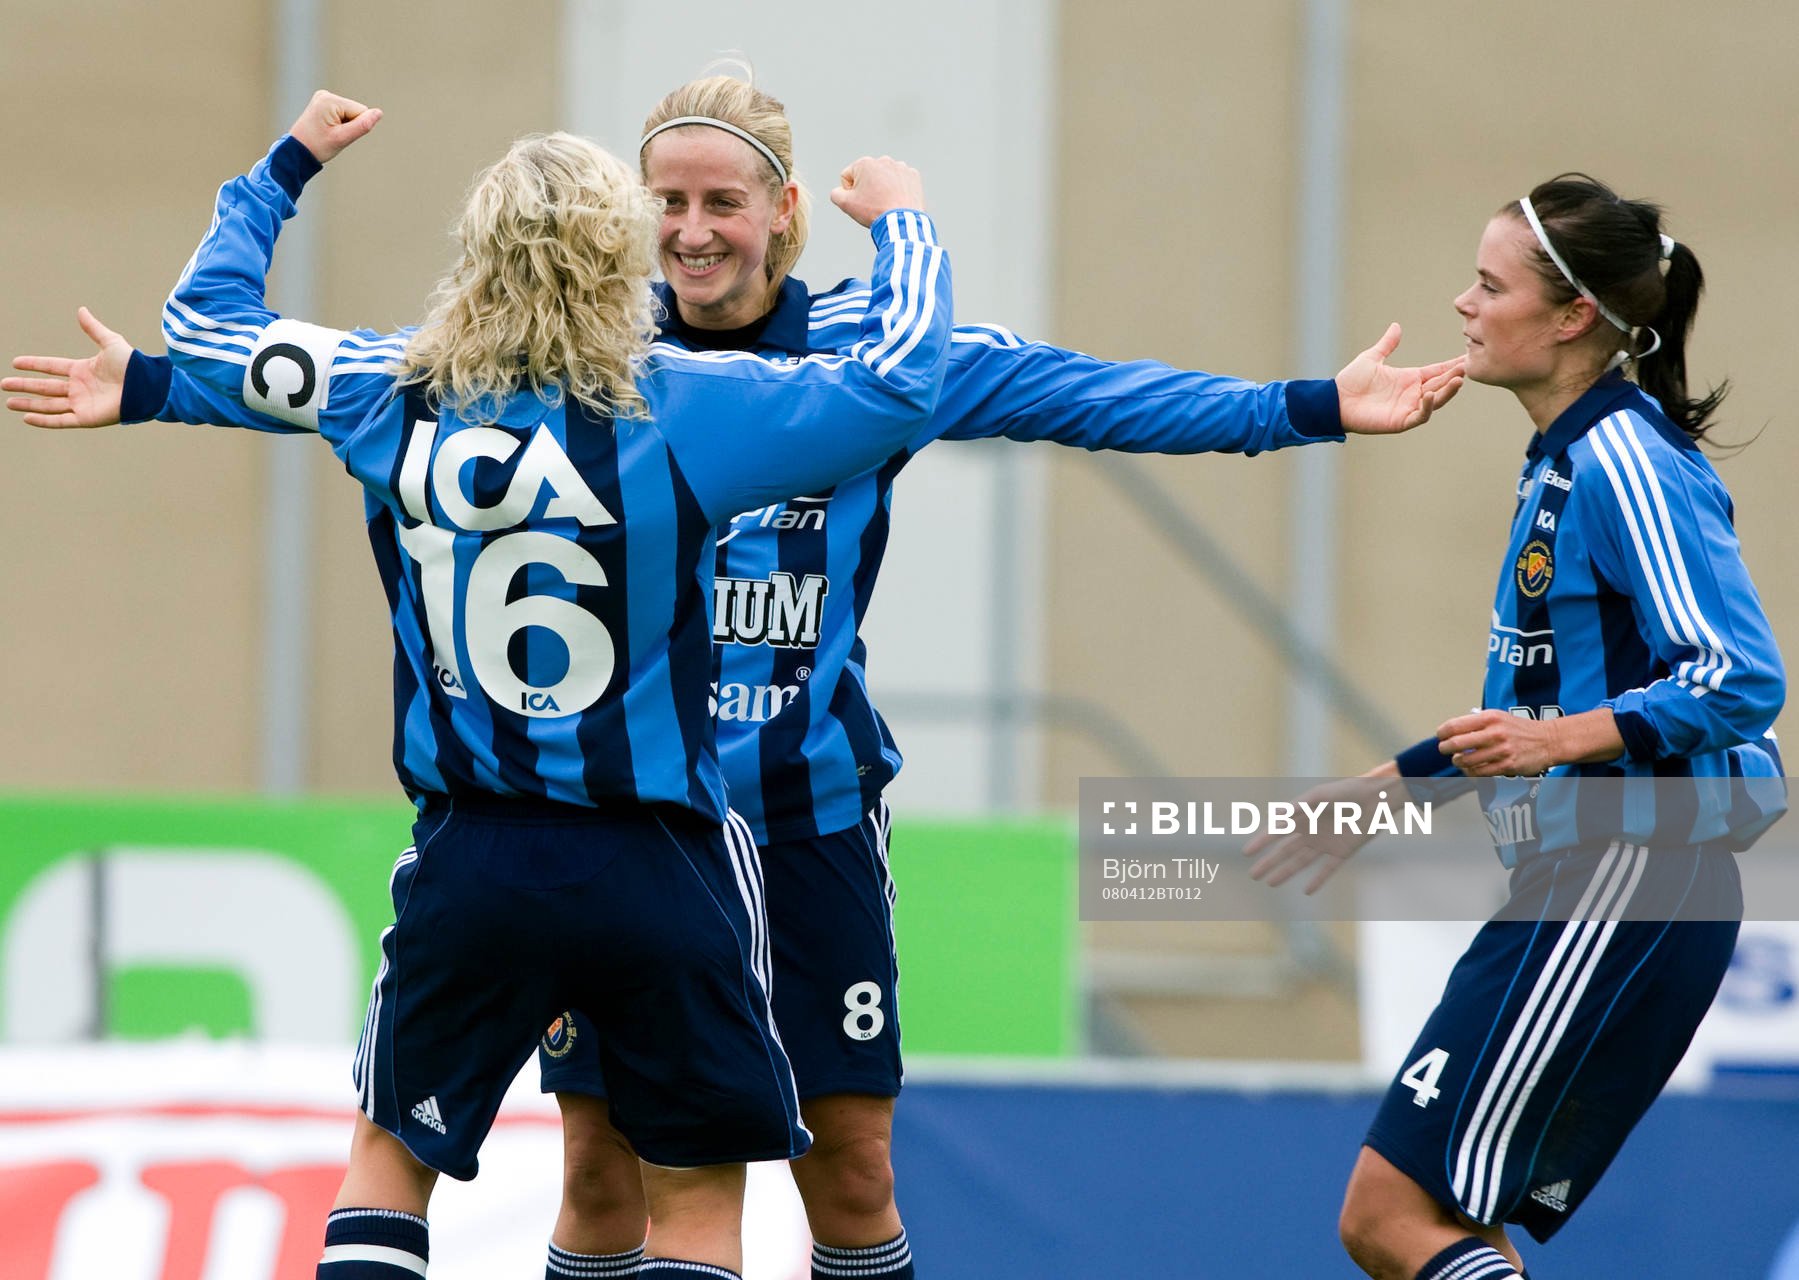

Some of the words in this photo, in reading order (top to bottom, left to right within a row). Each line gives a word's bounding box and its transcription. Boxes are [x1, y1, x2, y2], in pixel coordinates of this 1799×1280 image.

[250, 342, 316, 409] C
[397, 418, 618, 532] ICA
[1536, 508, 1556, 532] ICA
[398, 520, 616, 719] 16
[521, 691, 561, 712] ICA
[843, 980, 885, 1041] 8
[1400, 1047, 1450, 1108] 4
[411, 1107, 447, 1135] adidas
